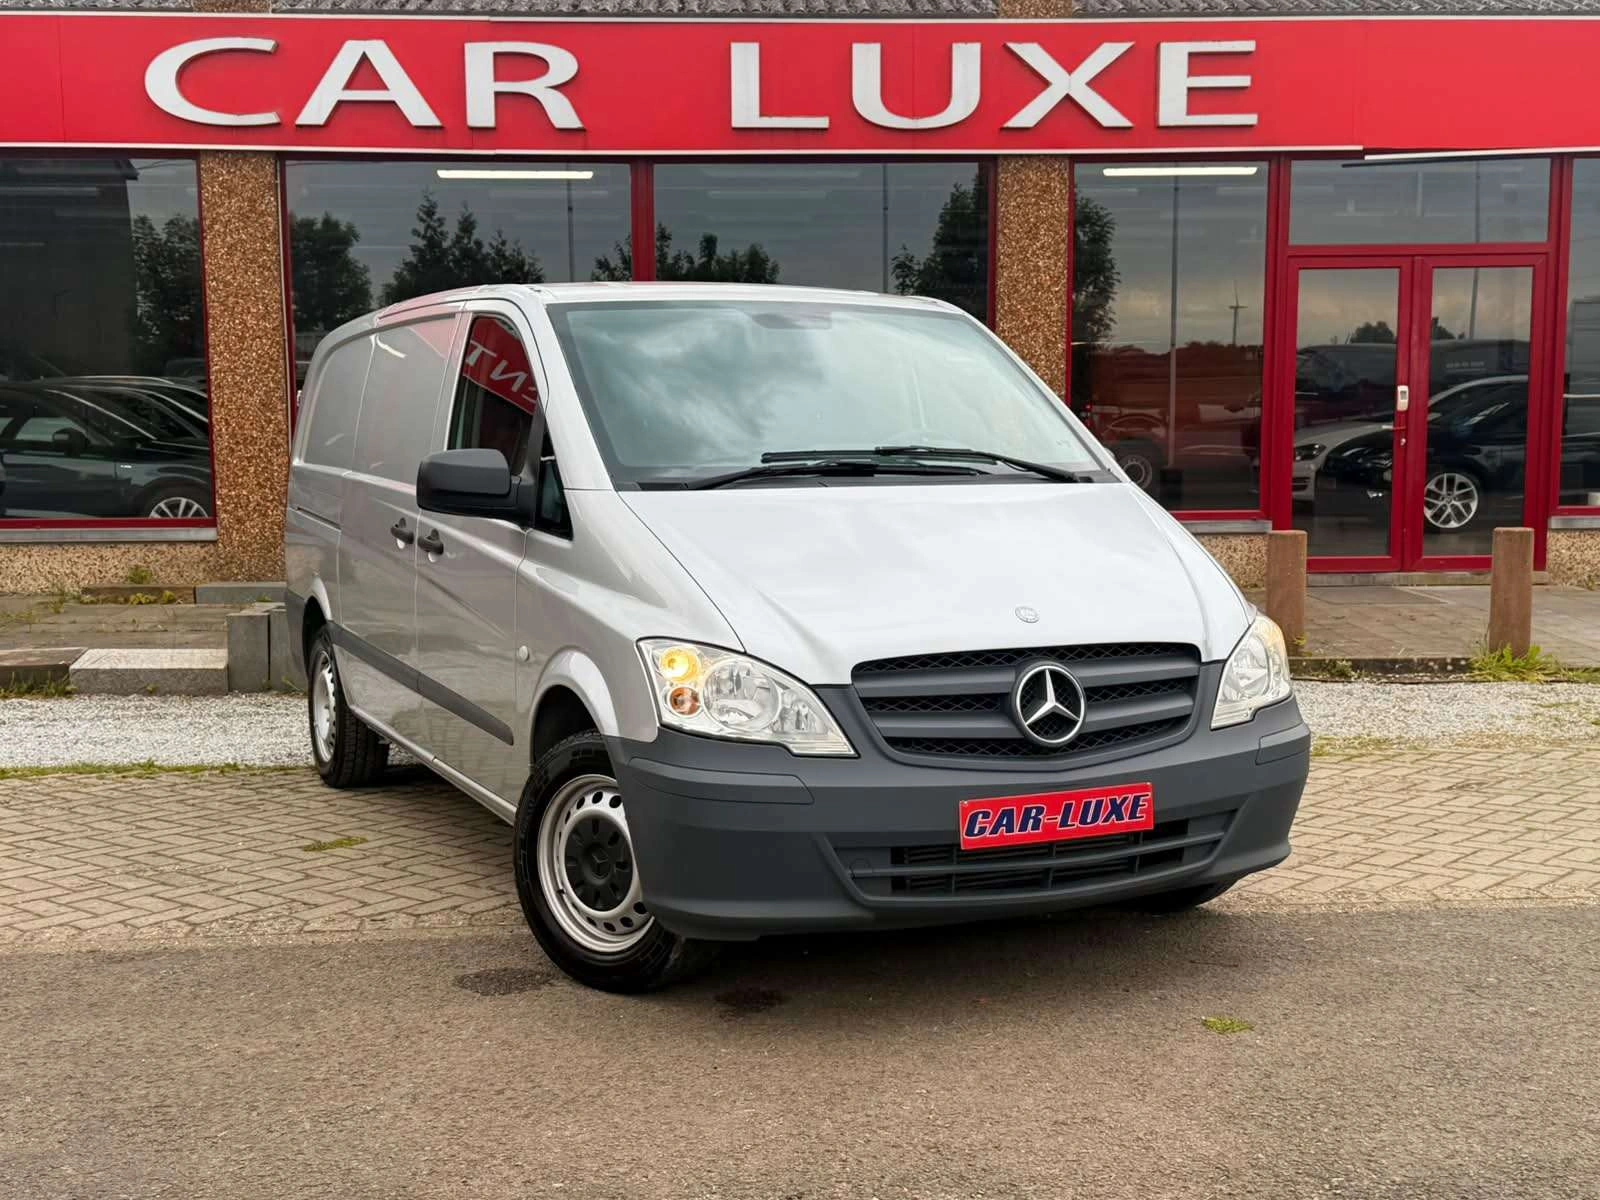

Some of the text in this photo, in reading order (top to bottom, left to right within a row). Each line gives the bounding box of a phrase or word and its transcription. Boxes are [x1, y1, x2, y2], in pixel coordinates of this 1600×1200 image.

[144, 36, 1259, 130] CAR LUXE
[963, 793, 1150, 838] CAR-LUXE
